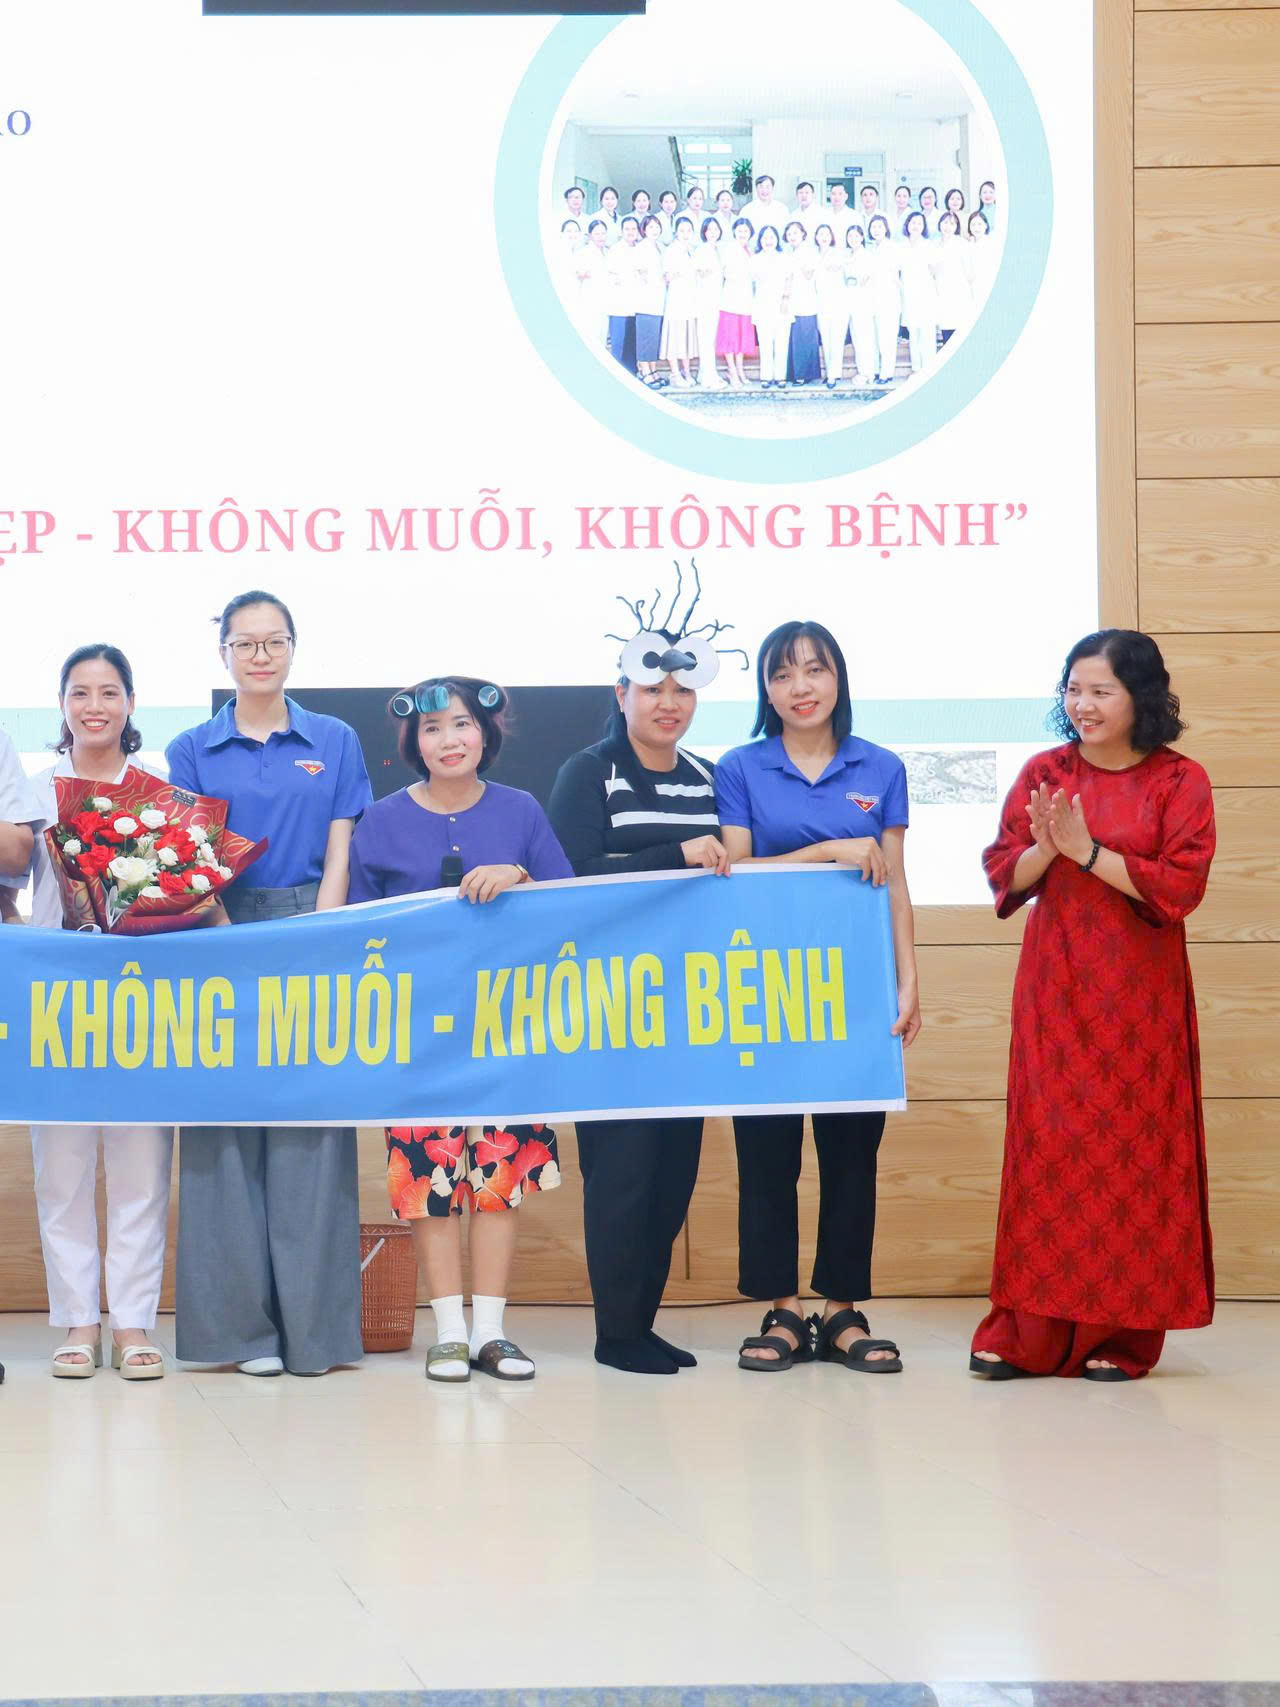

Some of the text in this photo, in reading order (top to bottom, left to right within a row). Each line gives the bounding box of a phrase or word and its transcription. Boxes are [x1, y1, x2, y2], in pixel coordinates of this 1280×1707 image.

[117, 497, 343, 553] KHÔNG
[369, 490, 553, 559] MUỖI,
[577, 494, 804, 550] KHÔNG
[829, 492, 1028, 559] BỆNH”
[30, 961, 235, 1070] KHÔNG
[257, 938, 413, 1067] MUỖI
[471, 941, 666, 1058] KHÔNG
[683, 928, 848, 1067] BỆNH
